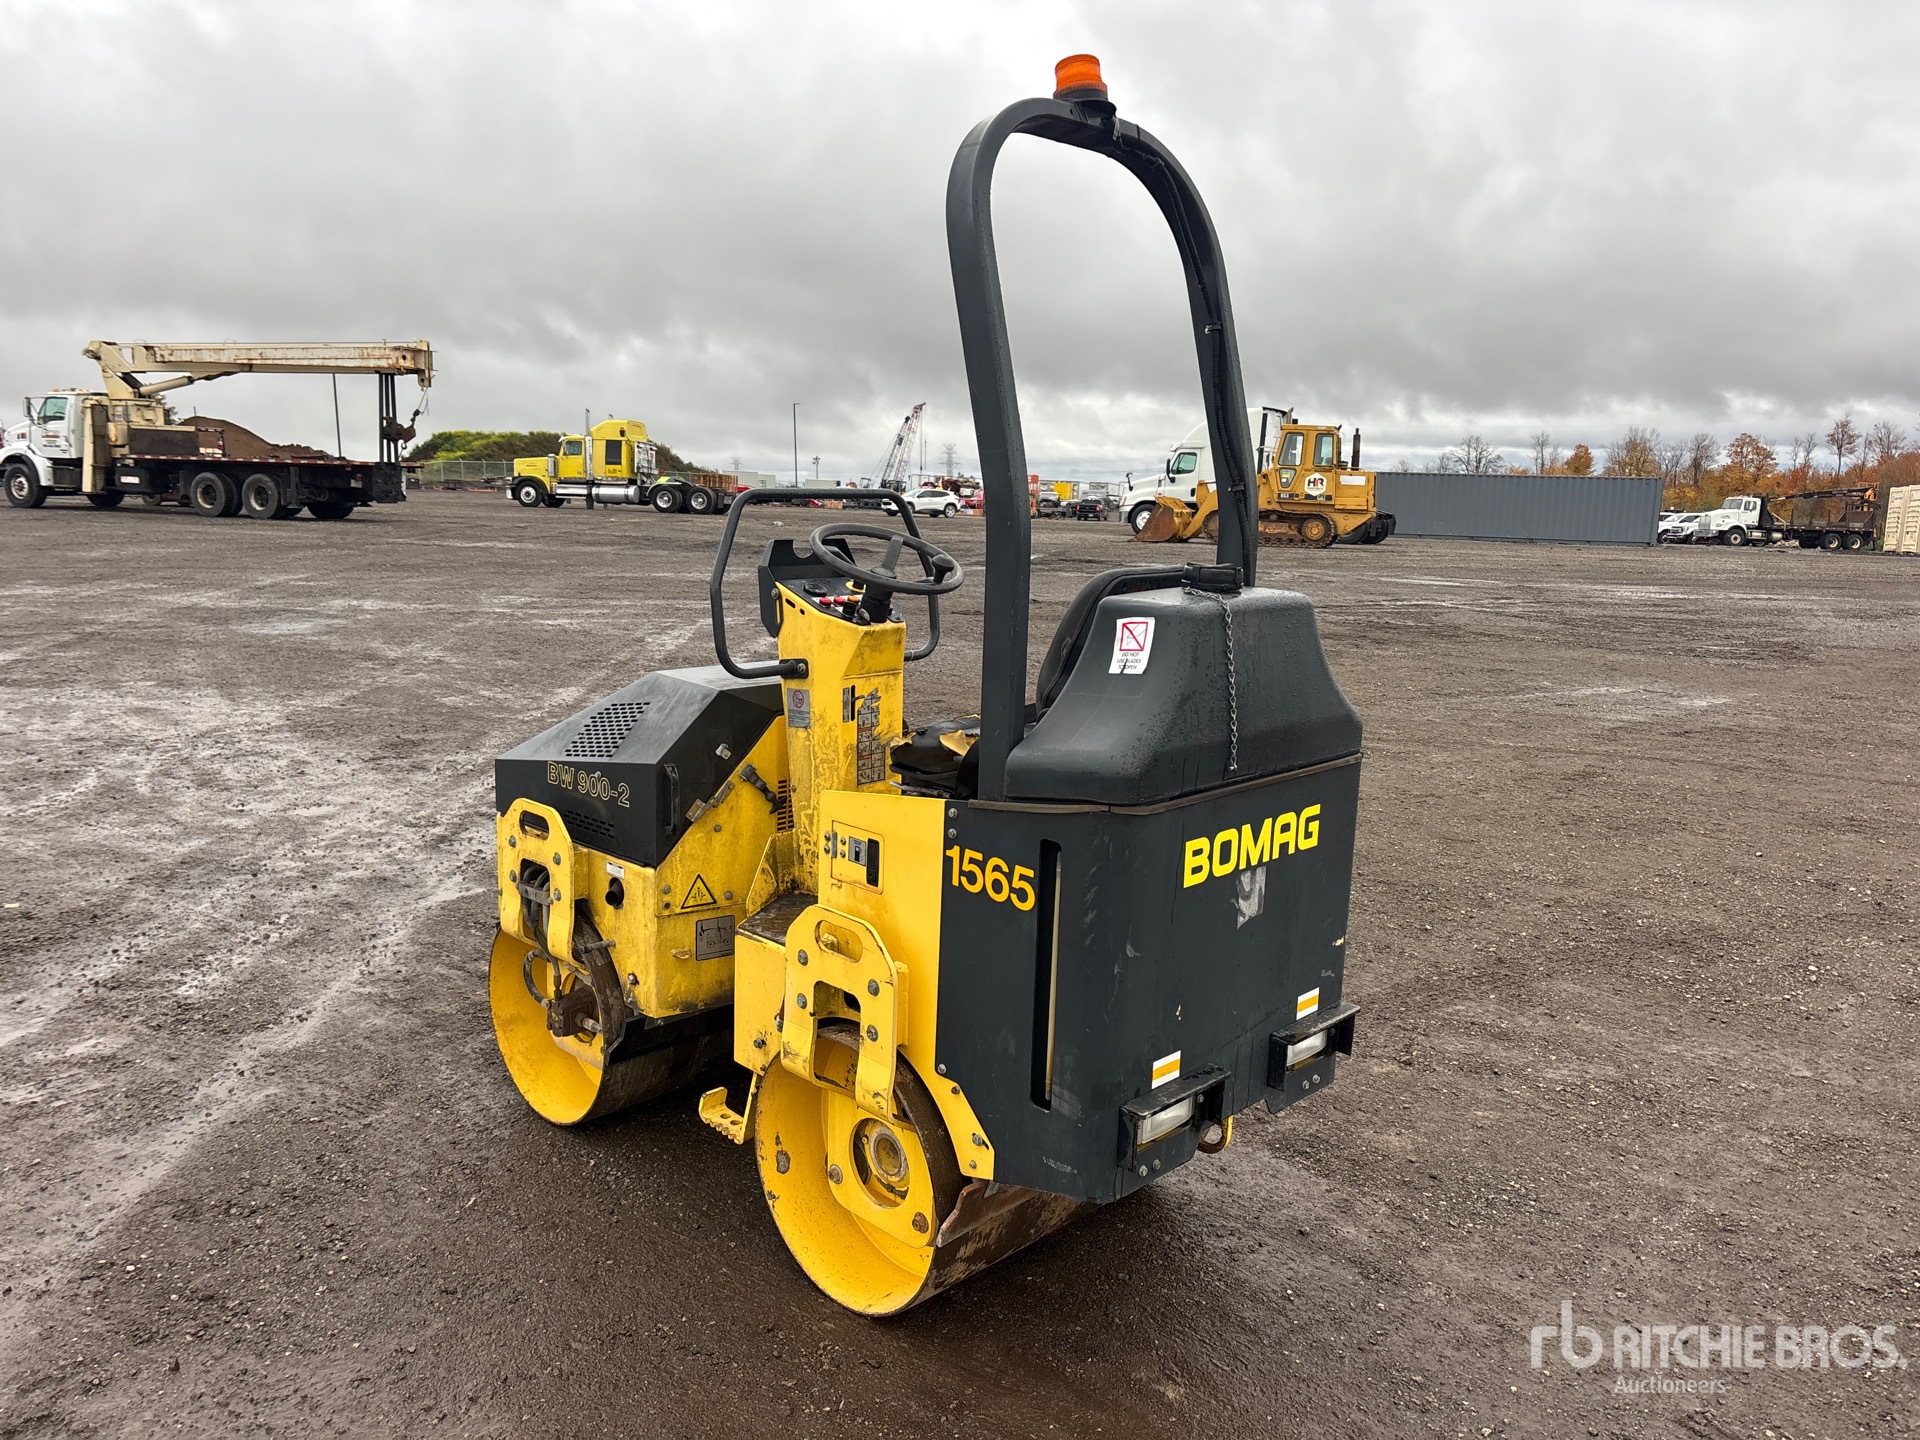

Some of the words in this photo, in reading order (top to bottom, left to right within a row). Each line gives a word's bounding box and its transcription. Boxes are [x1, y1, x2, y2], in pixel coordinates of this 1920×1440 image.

[548, 761, 575, 789] BW
[577, 770, 630, 808] 900-2
[945, 844, 1036, 912] 1565
[1183, 803, 1321, 889] BOMAG
